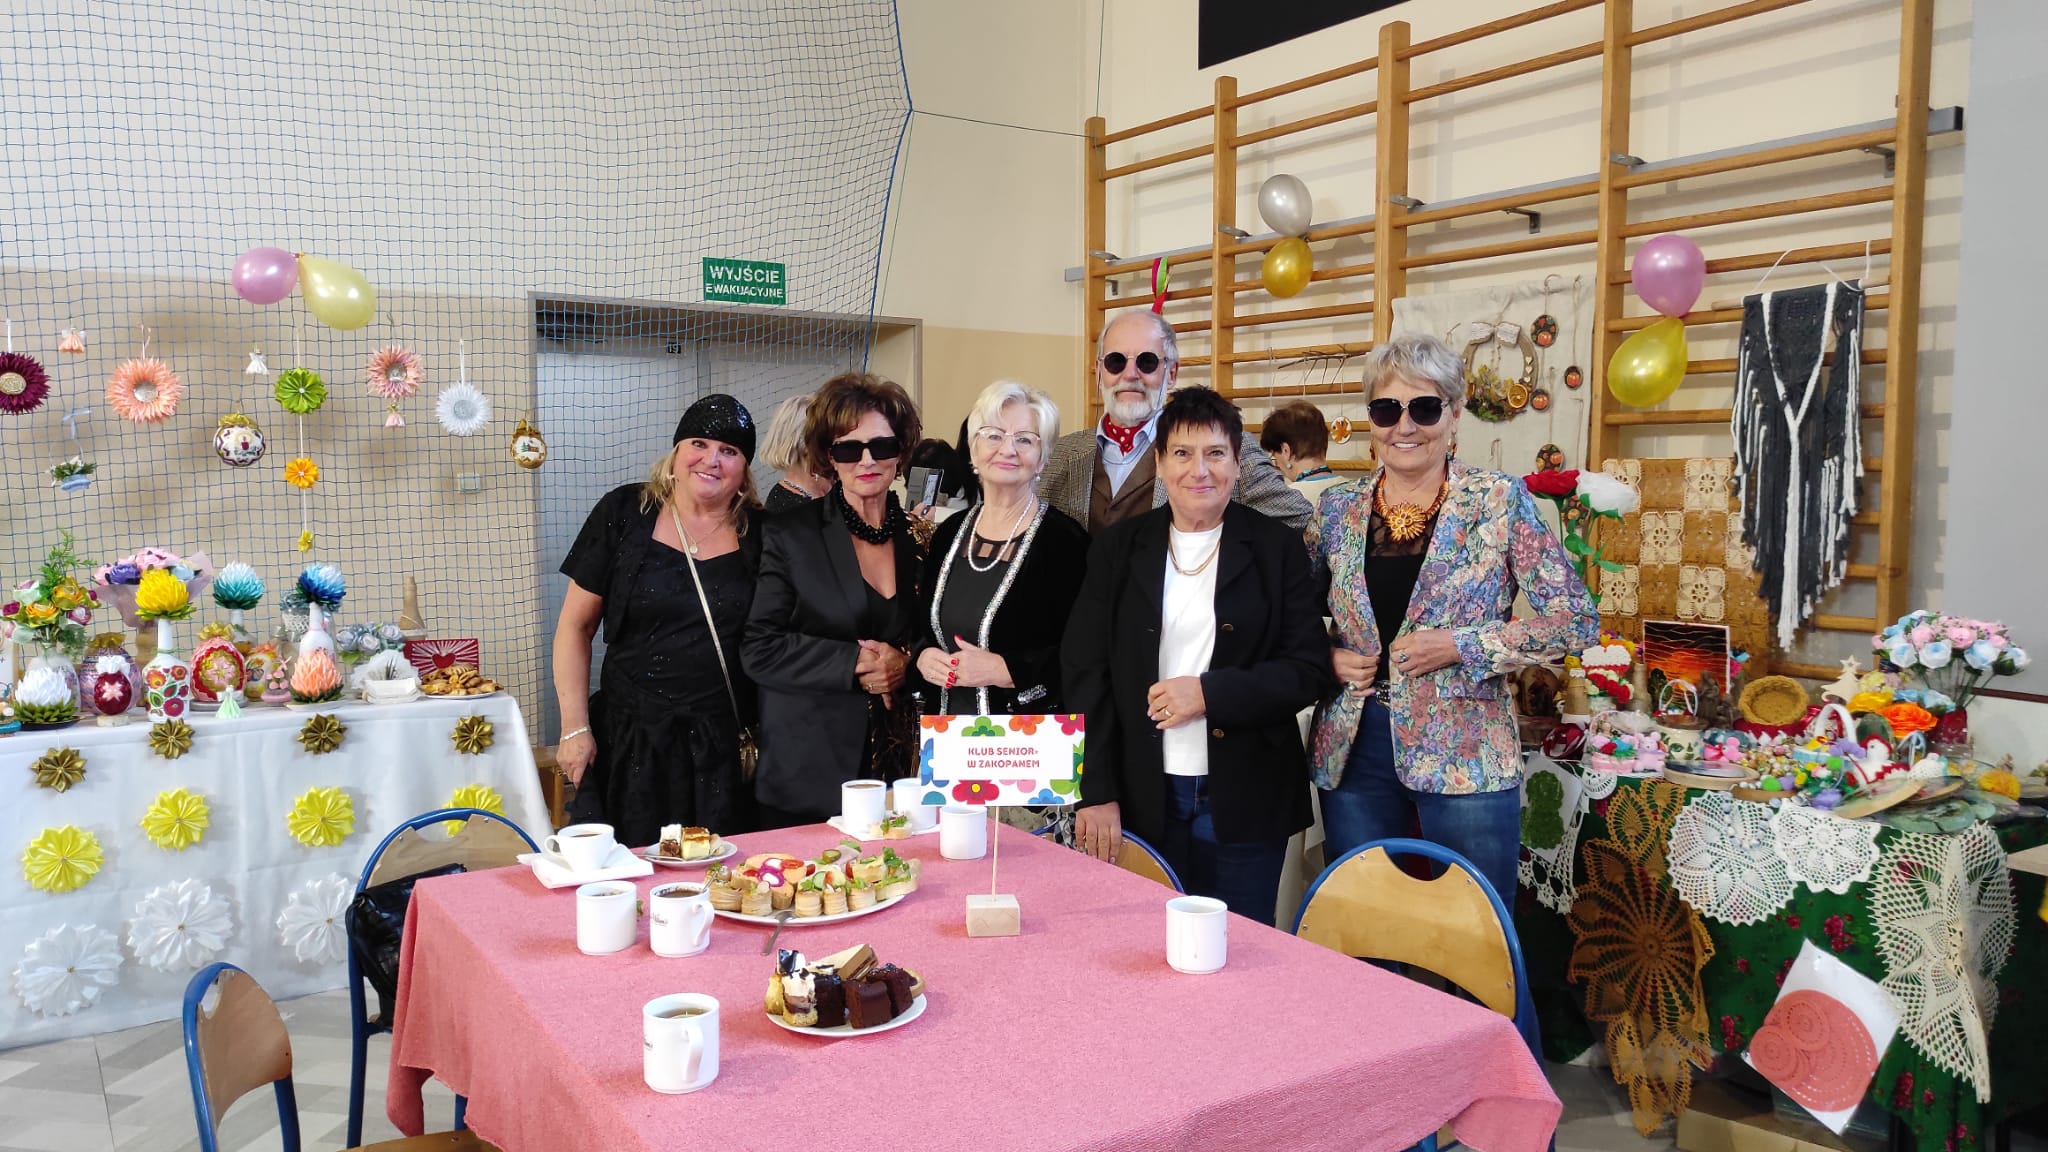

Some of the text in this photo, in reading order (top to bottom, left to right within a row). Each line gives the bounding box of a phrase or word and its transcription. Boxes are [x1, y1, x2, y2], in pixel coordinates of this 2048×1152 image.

[709, 264, 780, 284] WYJŚCIE
[705, 283, 784, 298] EWAKUACYJNE
[968, 747, 995, 756] KLUB
[967, 760, 1040, 768] W ZAKOPANEM
